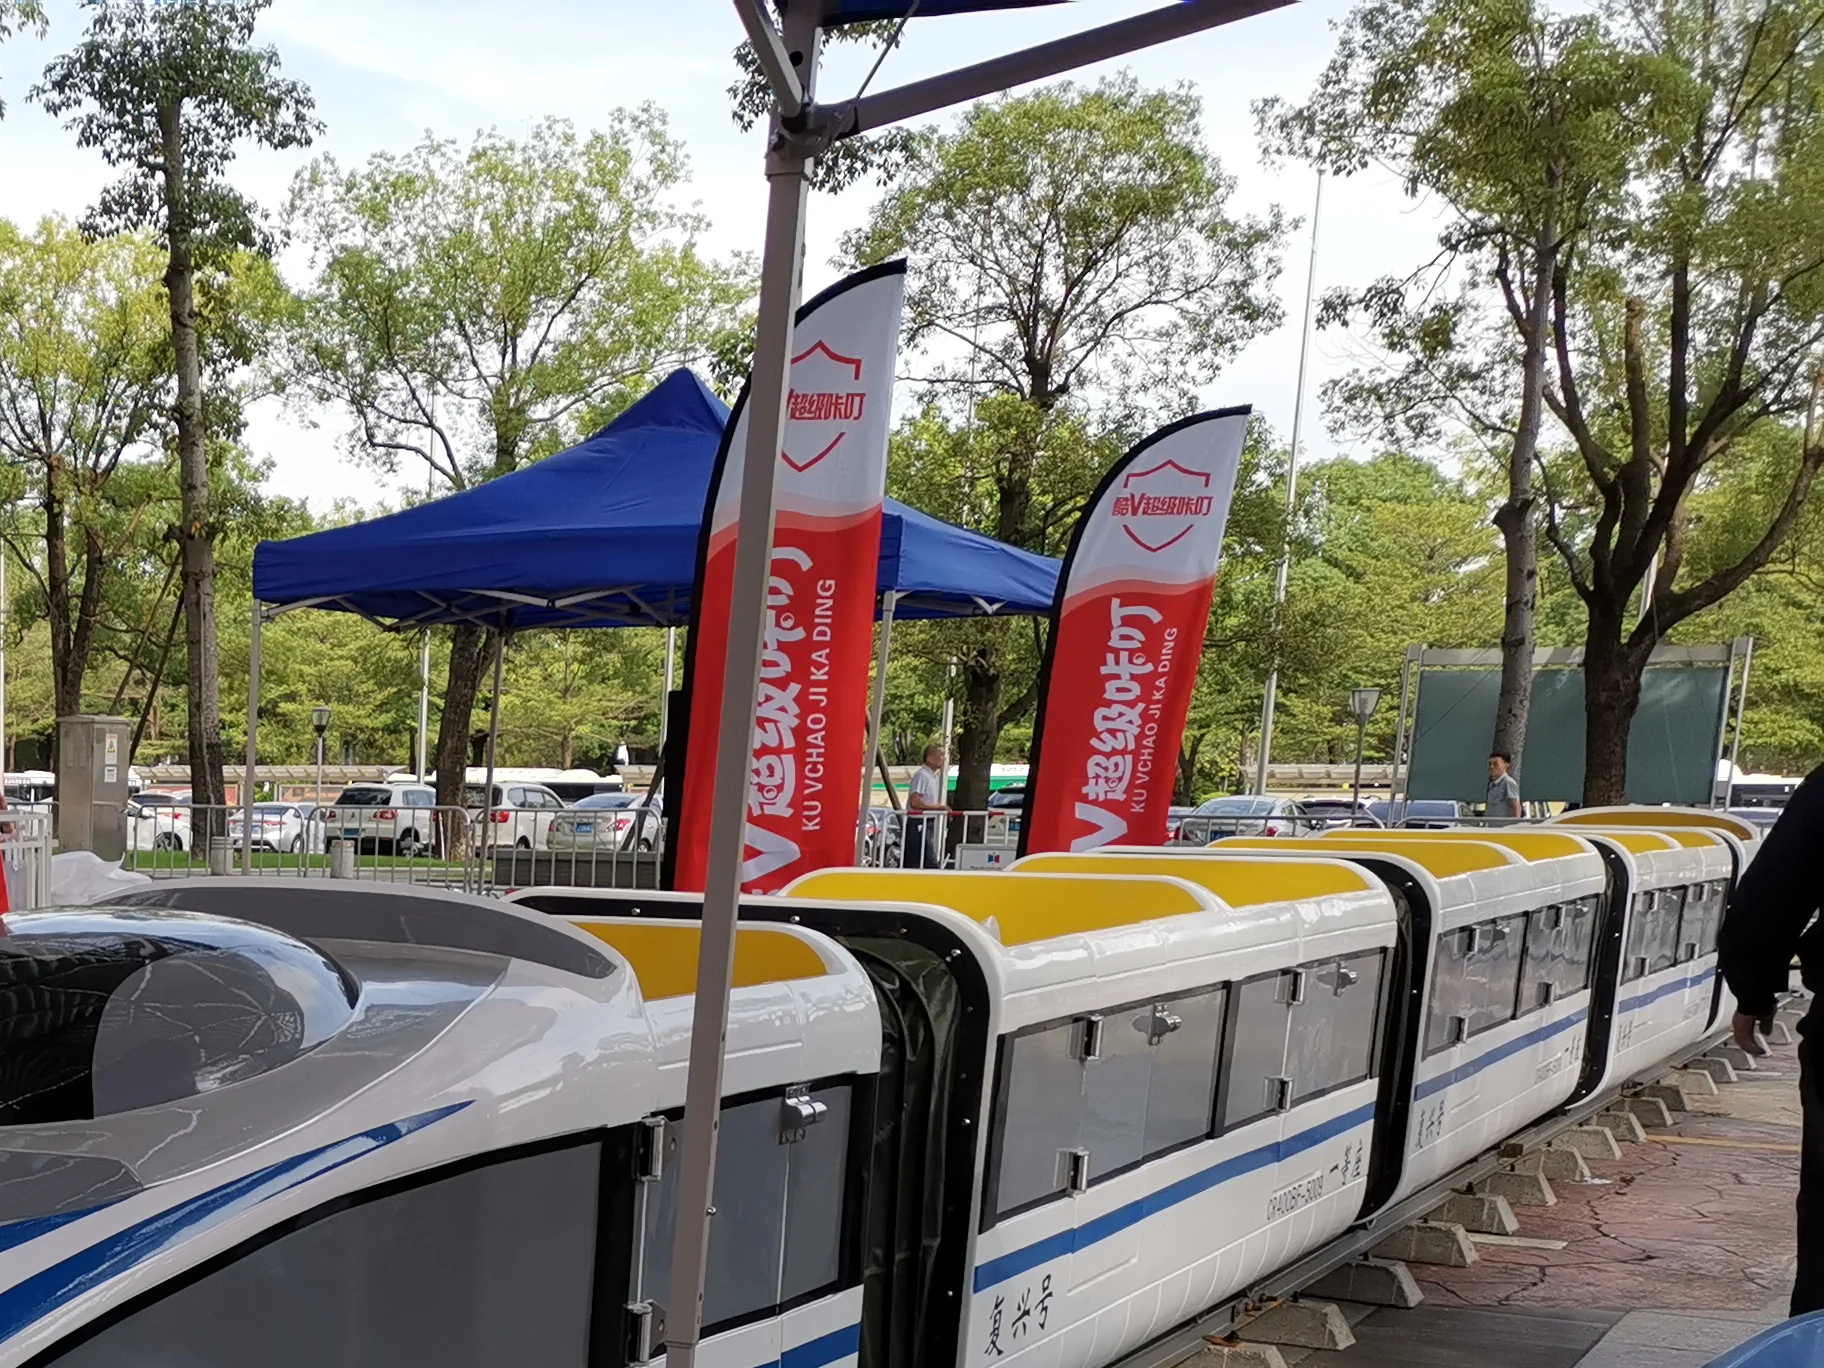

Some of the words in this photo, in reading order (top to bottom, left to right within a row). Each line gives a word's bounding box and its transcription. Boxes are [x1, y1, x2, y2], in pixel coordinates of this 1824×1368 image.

[1112, 492, 1215, 517] 酷V超级咔叮
[812, 579, 836, 641] DING
[810, 648, 830, 681] KA
[1158, 627, 1178, 673] DING
[808, 684, 828, 707] JI
[1152, 676, 1167, 701] KA
[1148, 703, 1162, 719] JI
[803, 713, 826, 796] VCHAO
[1136, 722, 1158, 786] VCHAO
[802, 801, 822, 831] KU
[1131, 788, 1147, 813] KU
[984, 1273, 1054, 1357] 复兴号
